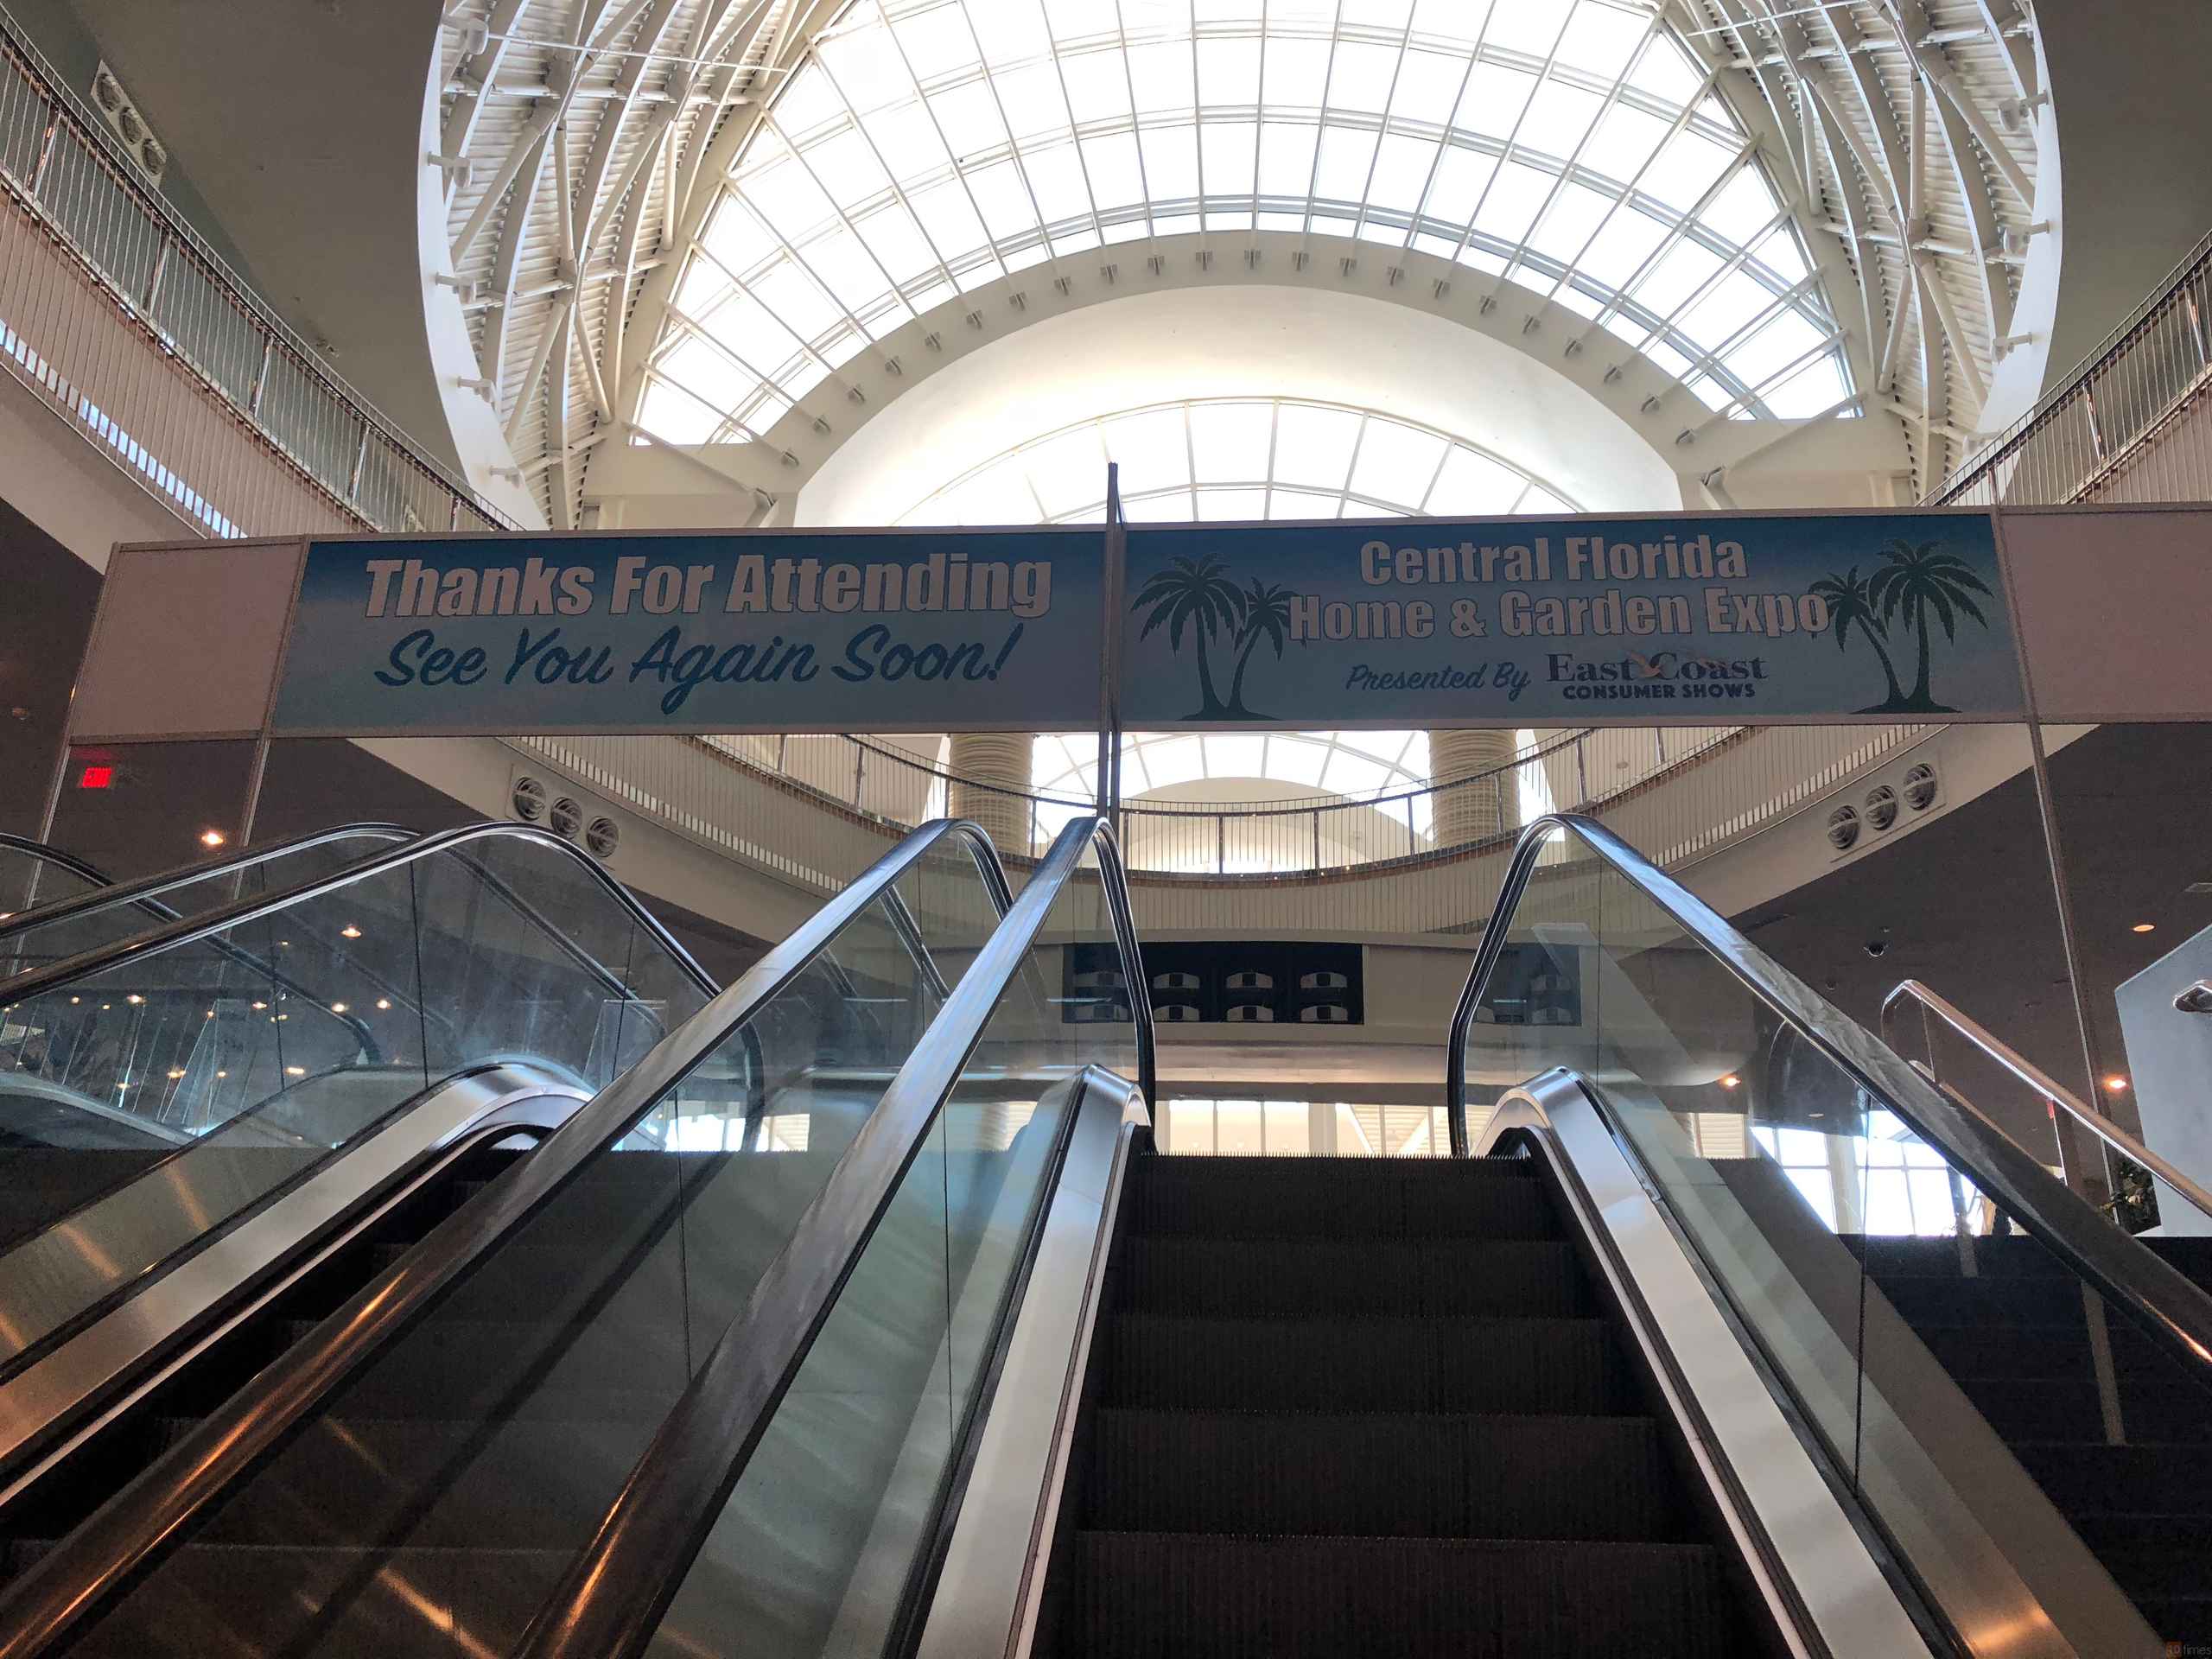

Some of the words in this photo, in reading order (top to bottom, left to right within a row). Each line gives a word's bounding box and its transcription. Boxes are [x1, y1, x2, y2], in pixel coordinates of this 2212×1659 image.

[365, 557, 595, 618] Thanks
[608, 556, 715, 614] For
[722, 552, 1052, 619] Attending
[1359, 536, 1553, 586] Central
[1564, 533, 1749, 581] Florida
[1288, 594, 1435, 640] Home
[1448, 598, 1488, 638] &
[1498, 588, 1692, 637] Garden
[1703, 586, 1829, 638] Expo
[373, 628, 487, 686] See
[504, 627, 614, 685] You
[628, 625, 820, 715] Again
[830, 622, 1024, 682] Soon!
[1344, 663, 1488, 691] Presented
[1491, 661, 1531, 702] By
[1544, 652, 1635, 683] East
[1648, 652, 1770, 681] Coast
[1562, 683, 1676, 701] CONSUMER
[1681, 683, 1756, 699] SHOWS
